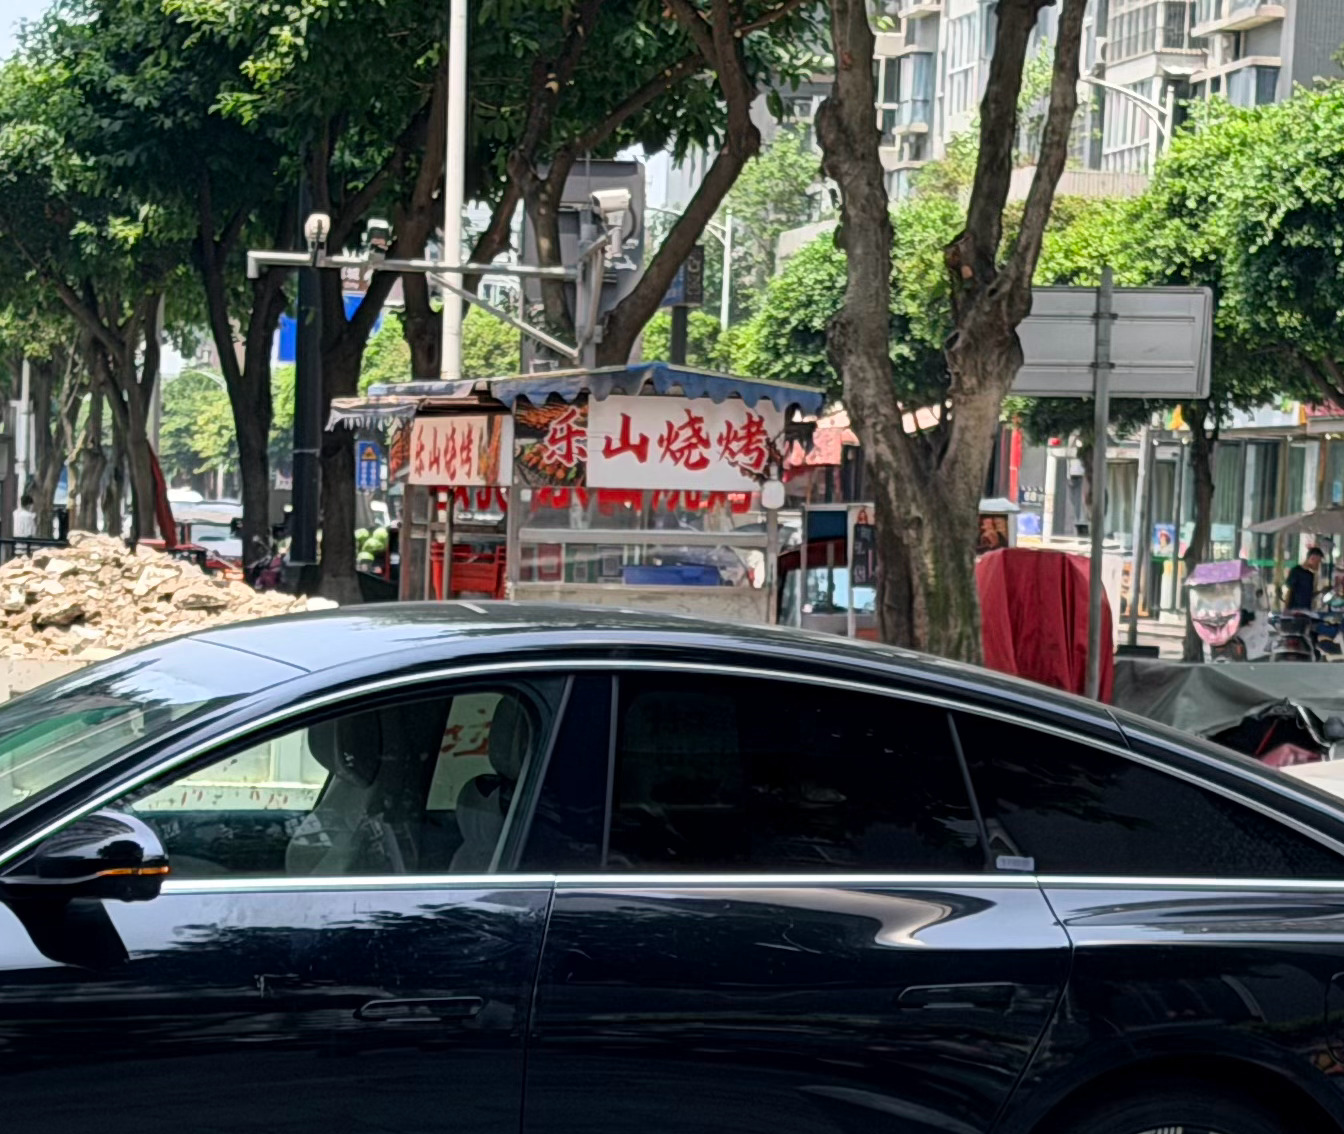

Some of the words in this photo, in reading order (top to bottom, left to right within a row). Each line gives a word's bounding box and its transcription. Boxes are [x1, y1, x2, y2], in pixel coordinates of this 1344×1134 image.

[415, 421, 473, 481] 乐山烧烤
[545, 405, 769, 472] 乐山烧烤
